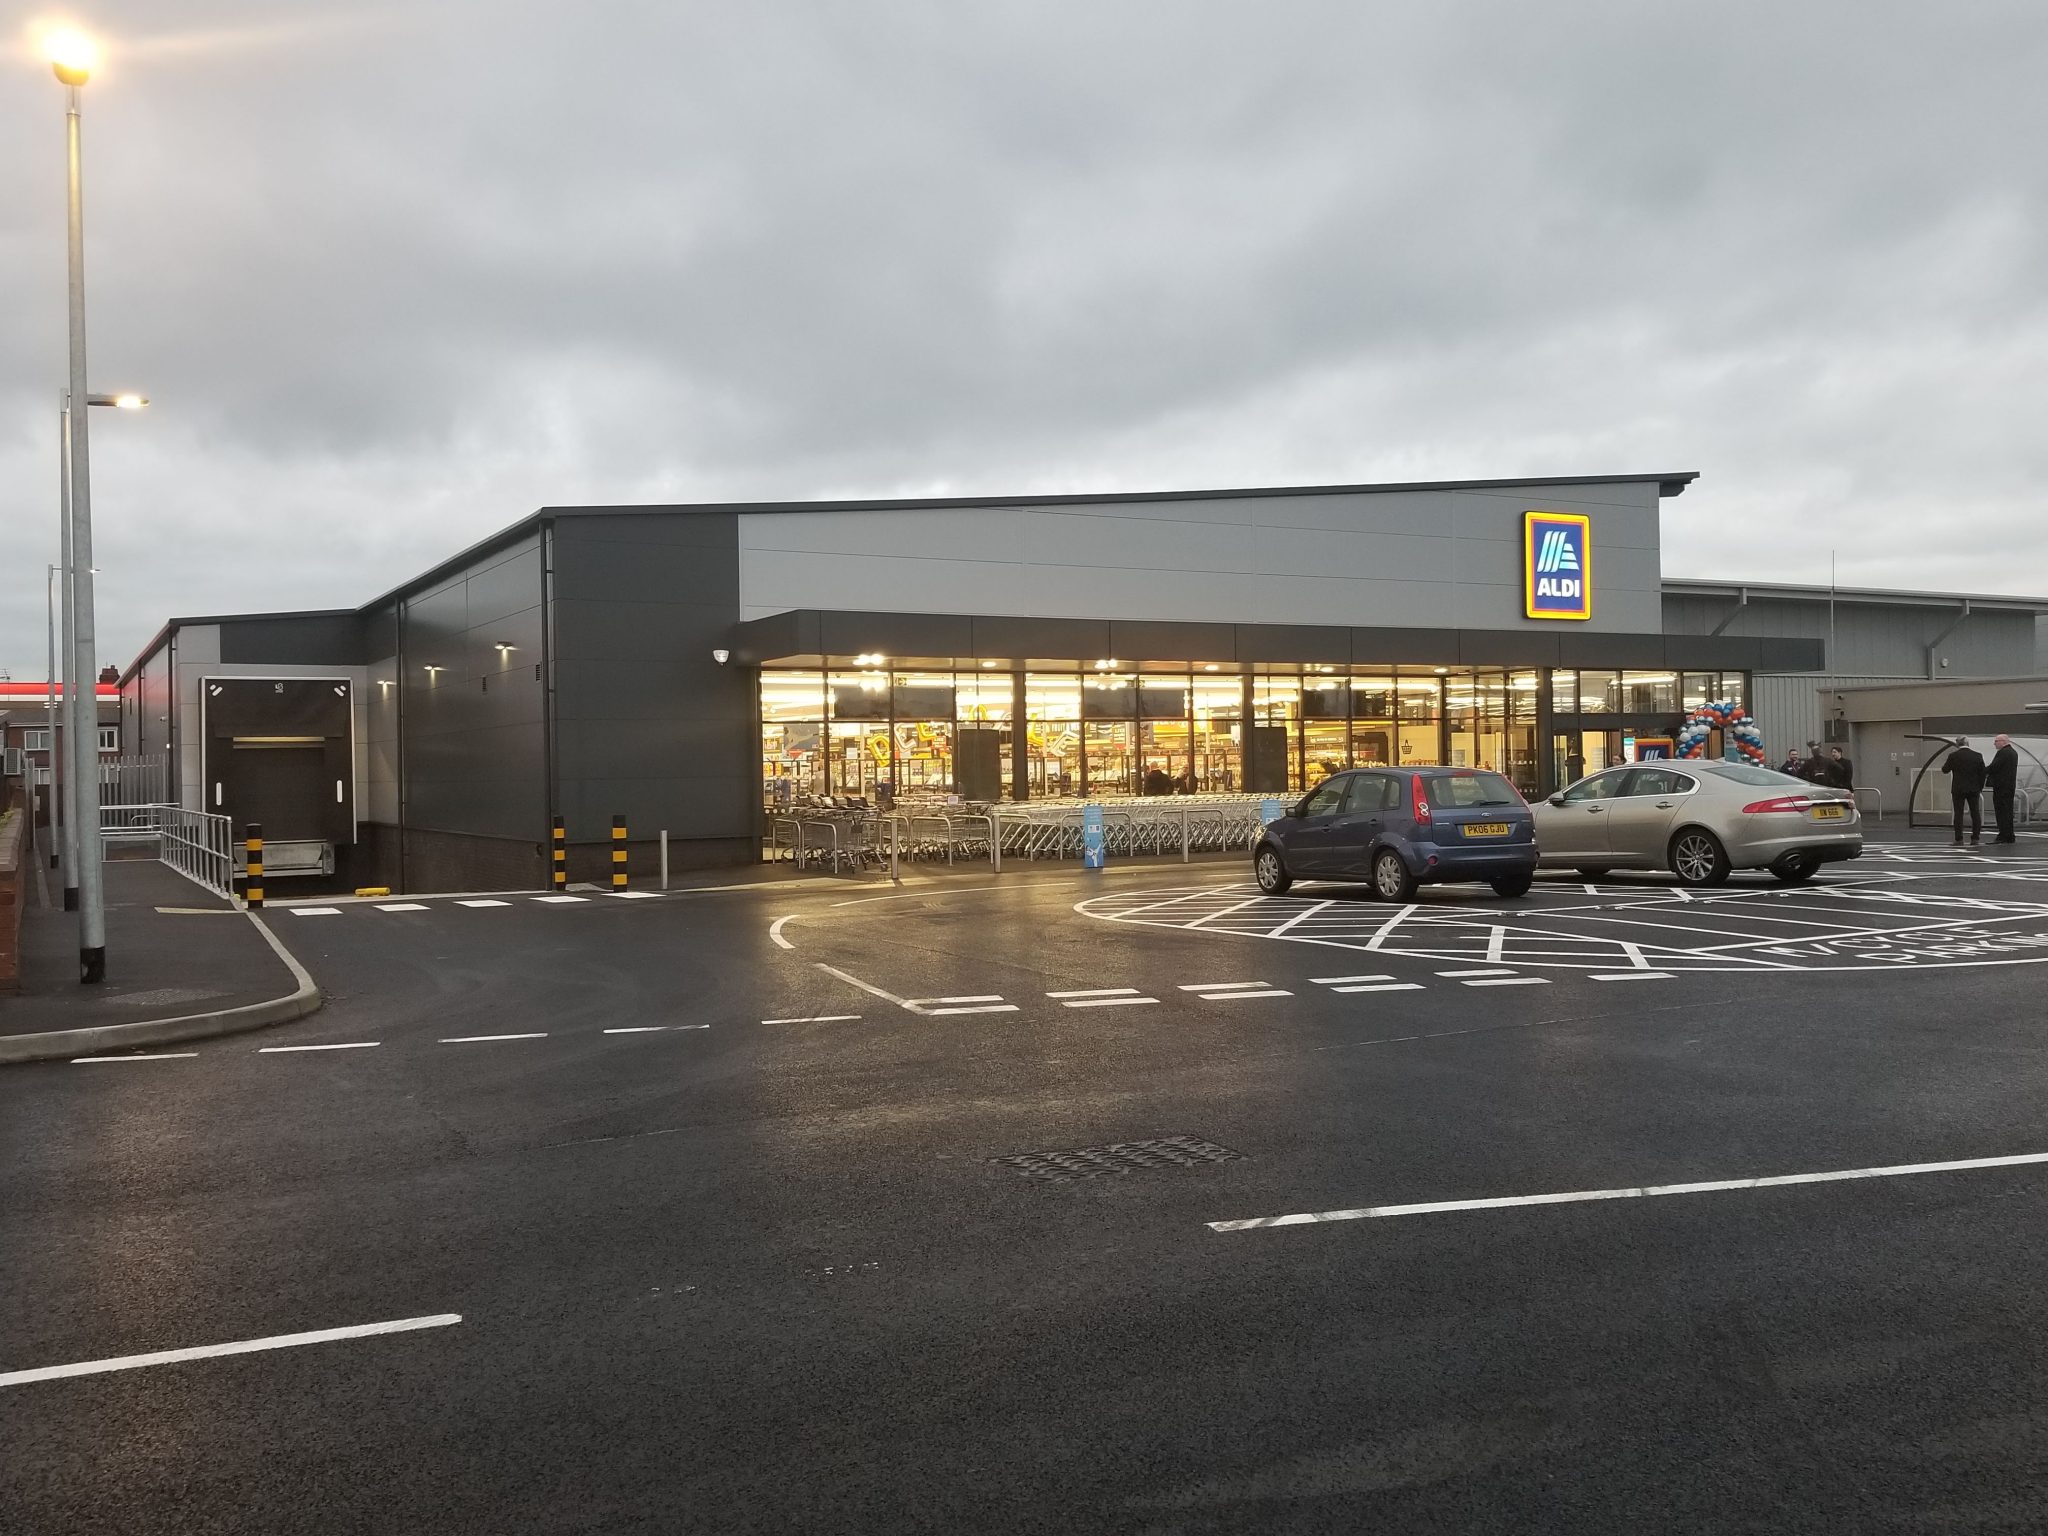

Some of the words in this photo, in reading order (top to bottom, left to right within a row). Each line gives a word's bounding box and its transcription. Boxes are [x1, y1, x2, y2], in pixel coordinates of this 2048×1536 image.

[1536, 577, 1580, 598] ALDI
[1467, 825, 1489, 835] PK06
[1490, 824, 1505, 834] GJU
[1752, 926, 2022, 958] M/CYCLE
